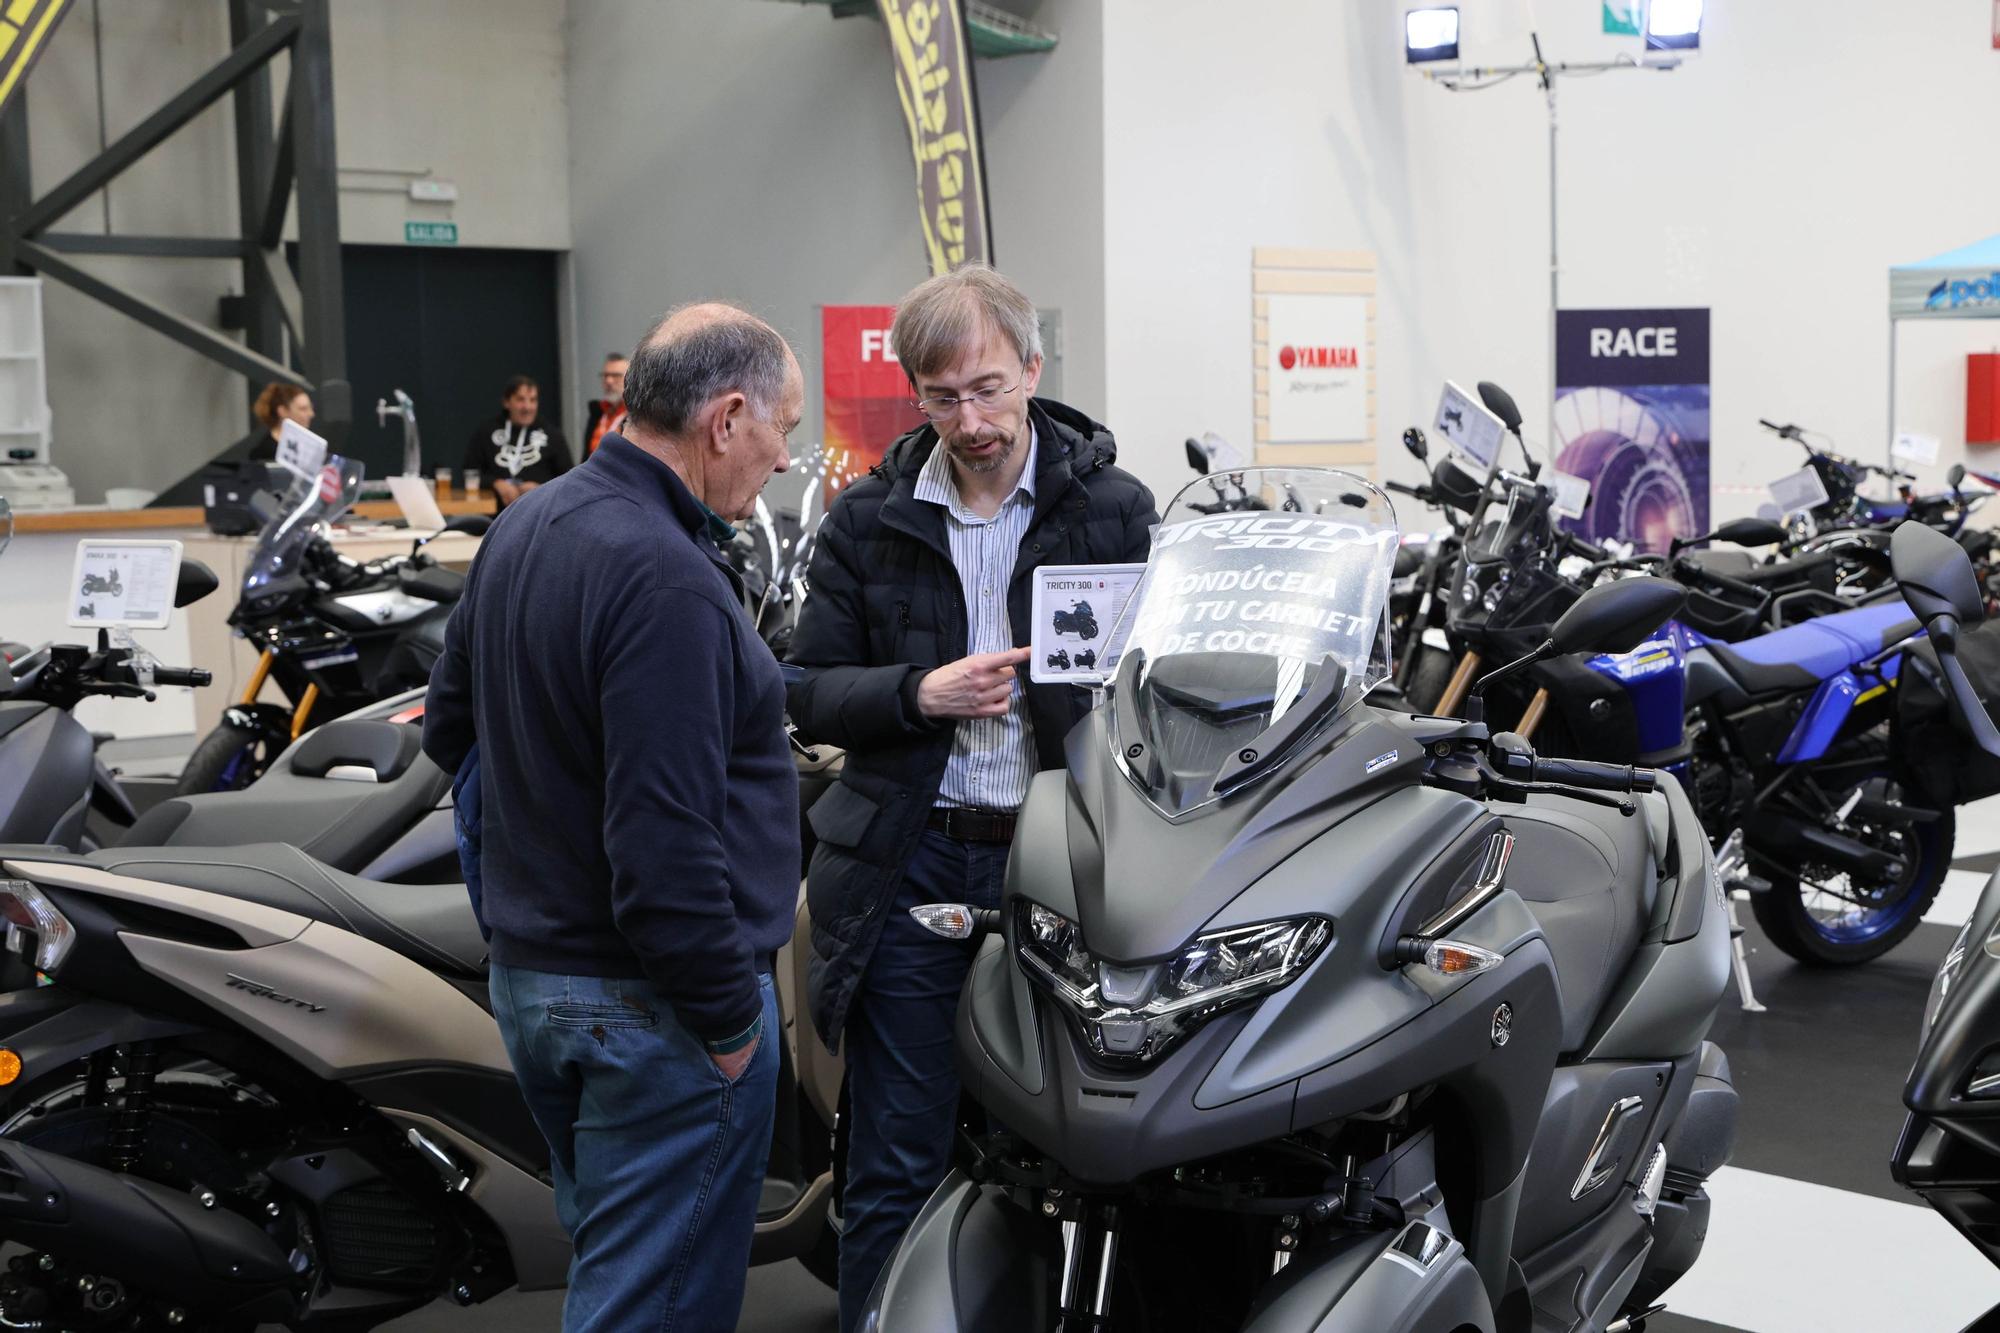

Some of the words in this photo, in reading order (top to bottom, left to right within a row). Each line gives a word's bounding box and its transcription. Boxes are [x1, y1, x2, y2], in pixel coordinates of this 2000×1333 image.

[1590, 327, 1678, 357] RACE
[1298, 346, 1358, 368] YAMAHA
[1156, 512, 1400, 550] TRICITY
[1214, 535, 1348, 553] 300
[1046, 581, 1076, 590] TRICITY
[1078, 581, 1092, 590] 300
[1194, 600, 1237, 622] TU
[1239, 600, 1369, 636] CARNET
[1160, 631, 1204, 656] DE
[1205, 630, 1313, 656] COCHE
[225, 972, 328, 1014] TRICITY
